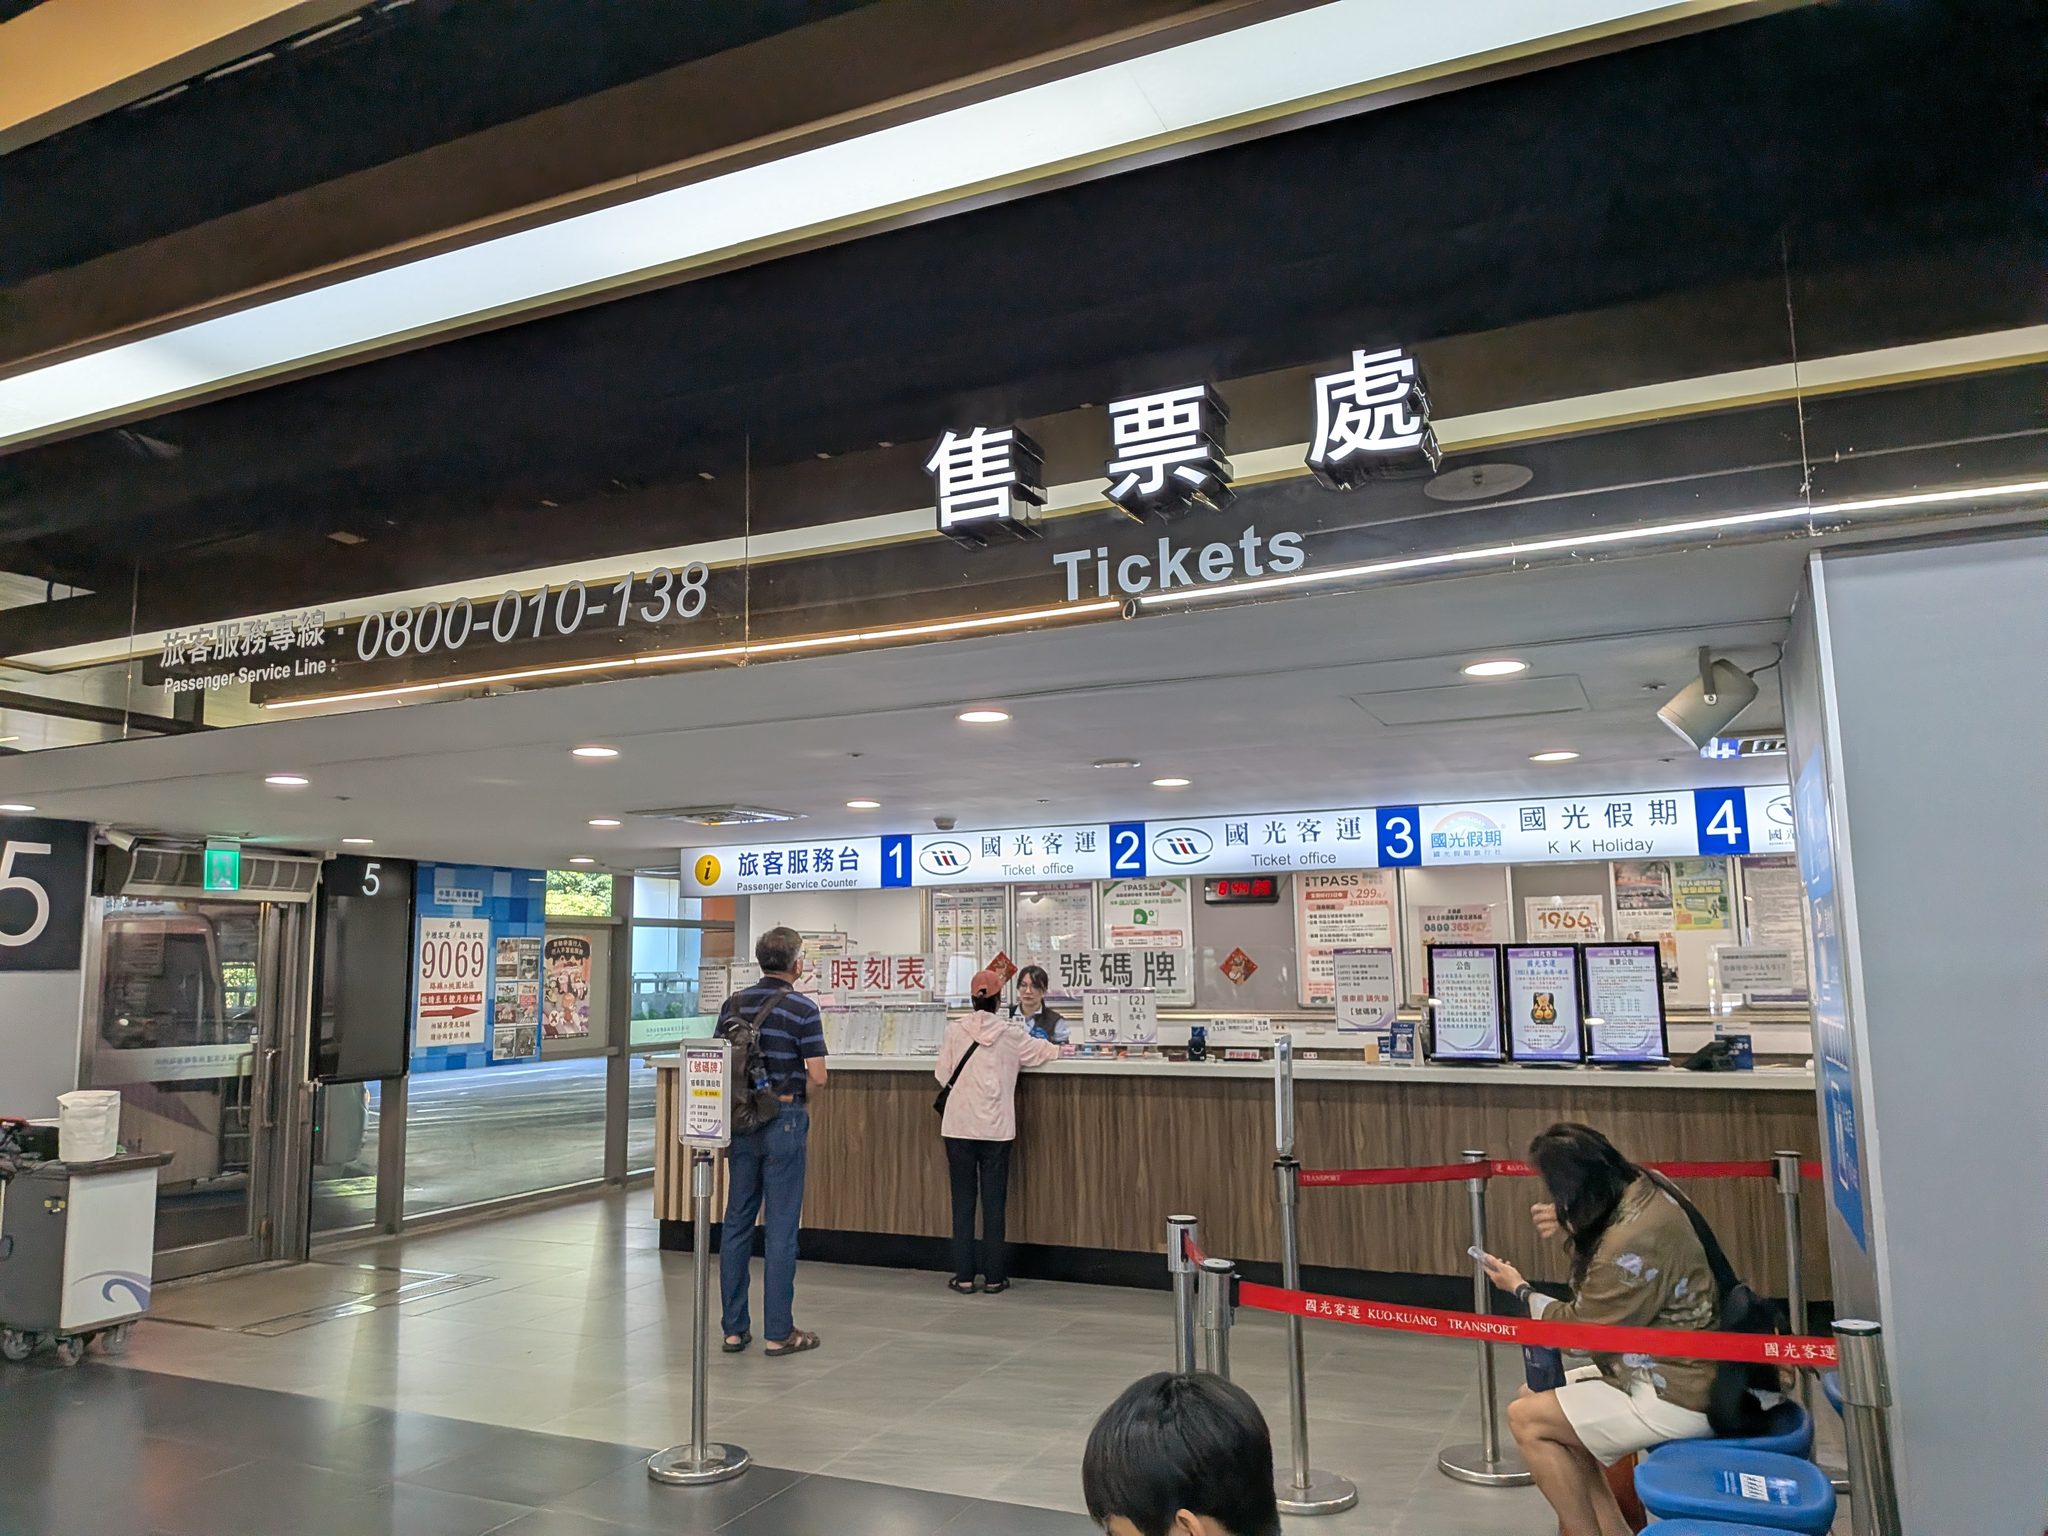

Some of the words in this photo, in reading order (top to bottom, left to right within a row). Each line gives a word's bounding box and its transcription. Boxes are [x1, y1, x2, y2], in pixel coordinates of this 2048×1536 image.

[928, 348, 1425, 528] 售票處
[1053, 525, 1304, 602] Tickets
[357, 561, 709, 661] 0800-010-138
[164, 673, 236, 693] Passenger
[238, 663, 290, 684] Service
[1519, 799, 1678, 832] 國光假期
[1705, 799, 1742, 845] 4
[981, 831, 1097, 858] 國光客運
[1225, 817, 1362, 847] 國光客運
[1385, 816, 1414, 859] 3
[1431, 830, 1502, 849] 國光假期
[1548, 841, 1560, 854] K
[1570, 840, 1582, 853] K
[1592, 838, 1655, 854] Holiday
[737, 846, 860, 877] 旅客服務台
[888, 842, 902, 879] 1
[1115, 830, 1141, 870] 2
[1251, 853, 1291, 867] Ticket
[1299, 851, 1337, 865] office
[361, 863, 381, 896] 5
[1001, 864, 1036, 876] Ticket
[1042, 862, 1074, 875] office
[1311, 875, 1359, 887] TPASS
[0, 840, 52, 947] 5
[736, 880, 782, 893] Passenger
[785, 879, 819, 890] Service
[821, 878, 858, 888] Counter
[1538, 911, 1592, 929] 1966
[422, 941, 485, 979] 9069
[830, 955, 926, 991] 時刻表
[1059, 951, 1177, 988] 號碼牌
[1456, 961, 1471, 970] 公告
[1092, 1012, 1114, 1023] 自取
[1303, 1174, 1341, 1182] TRANSPORT
[1305, 1298, 1361, 1320] 國光客運
[1368, 1308, 1438, 1327] KUO-KUANG
[1447, 1317, 1519, 1337] TRANSPORT
[1764, 1341, 1838, 1361] 國光客運
